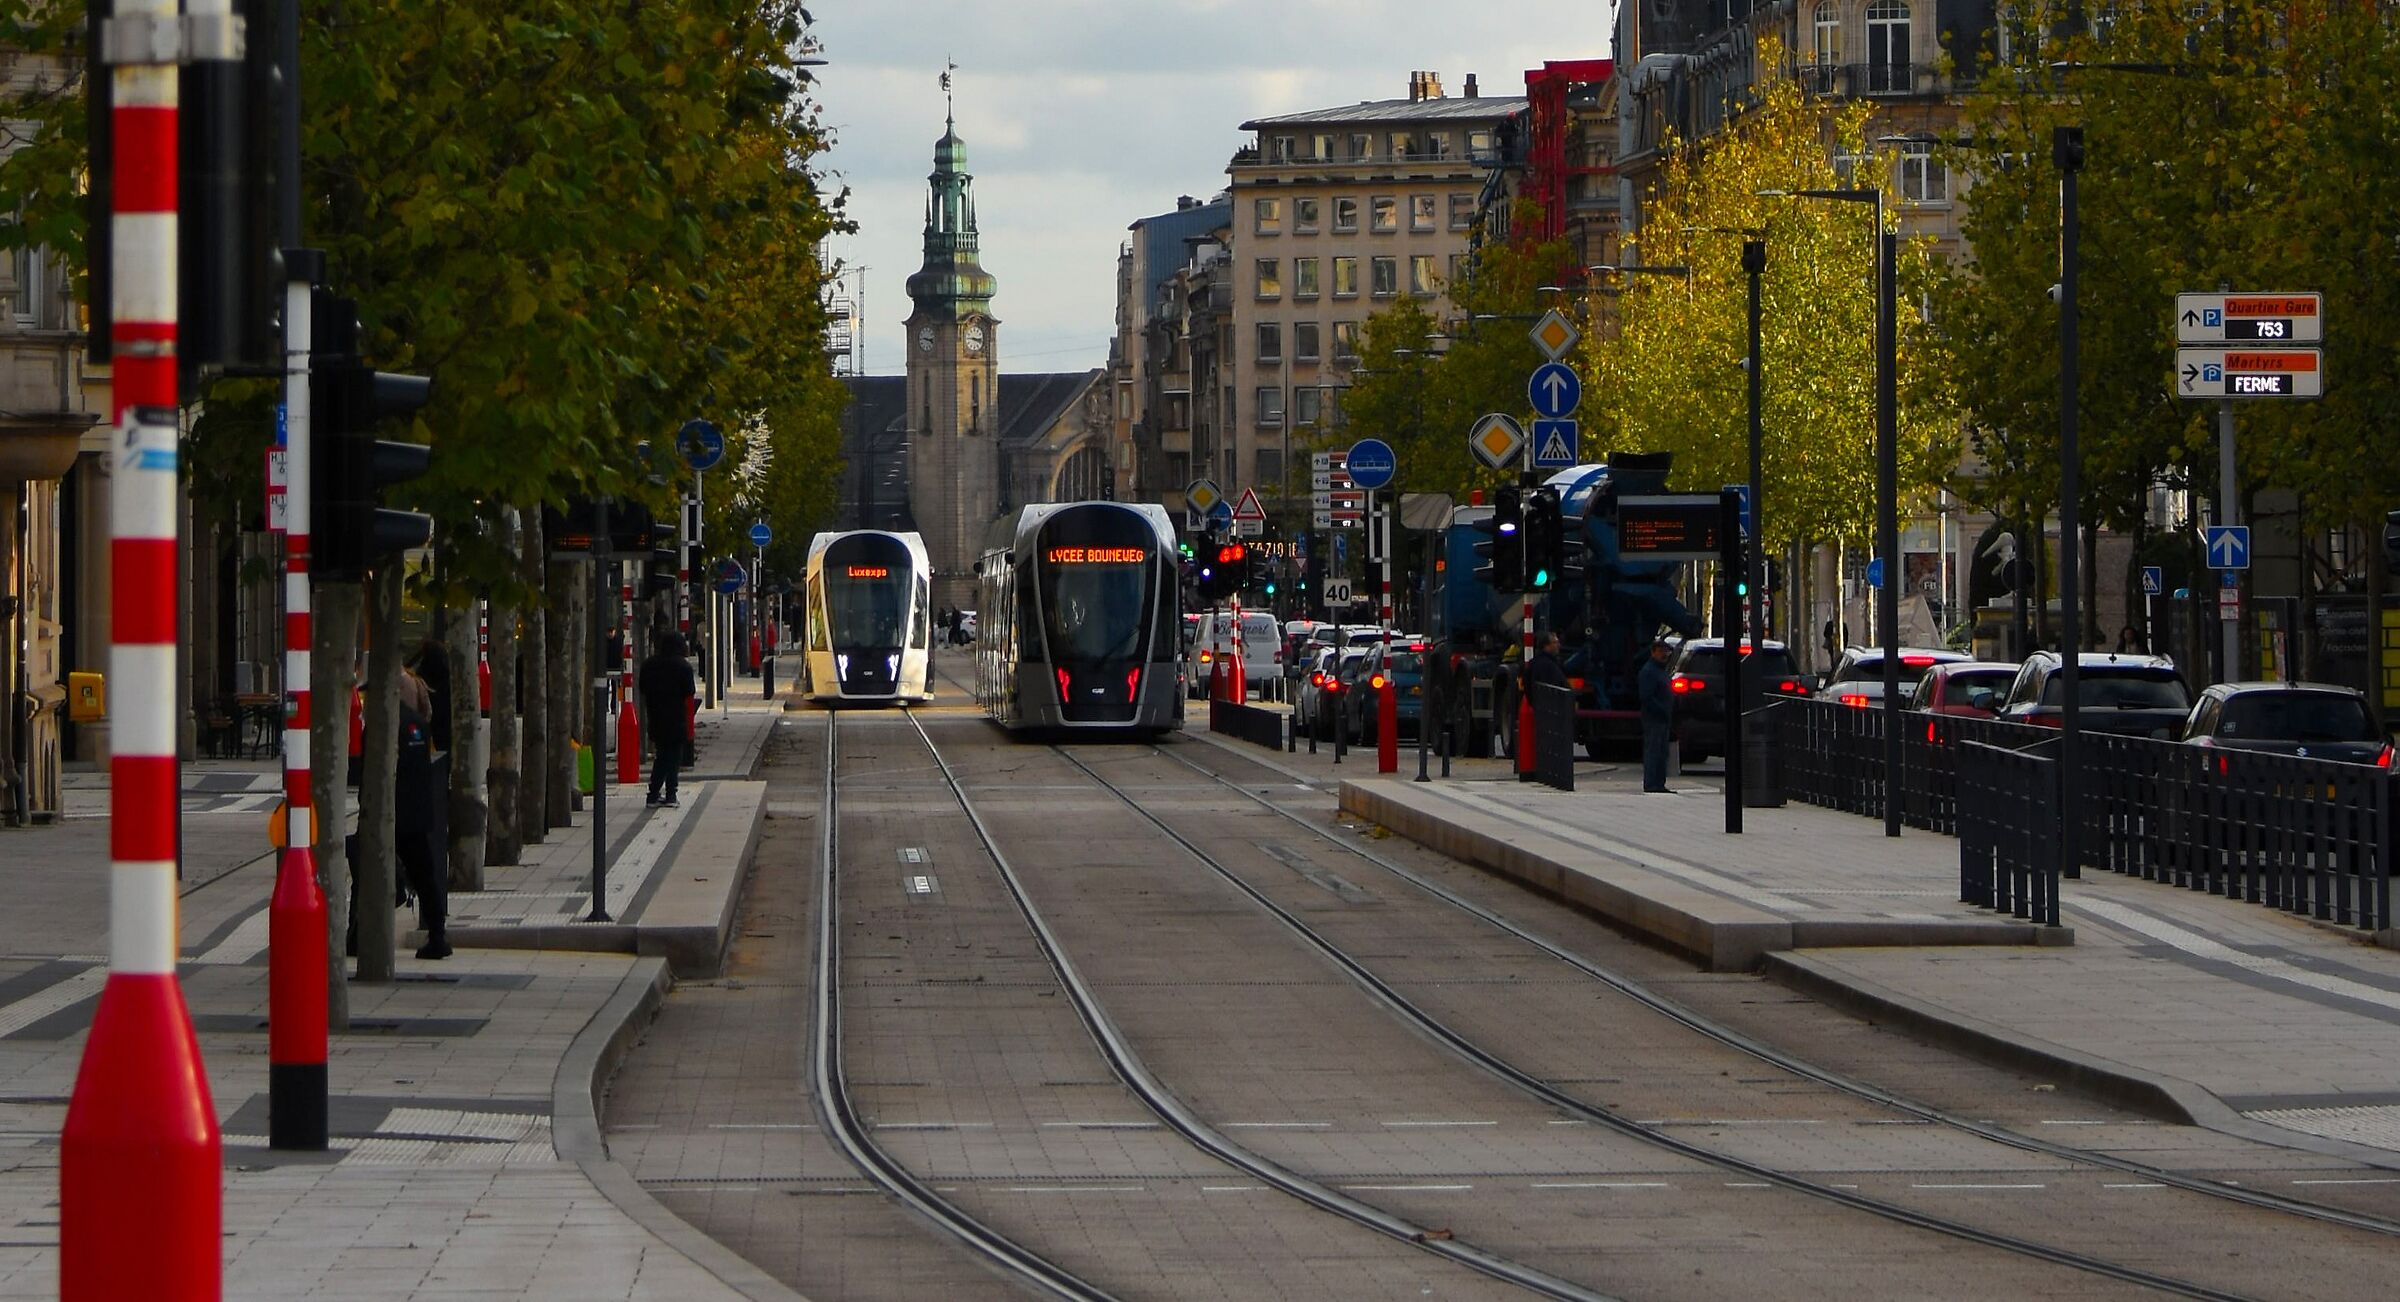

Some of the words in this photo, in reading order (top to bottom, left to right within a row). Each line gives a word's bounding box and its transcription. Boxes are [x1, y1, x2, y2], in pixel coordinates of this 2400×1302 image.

[2226, 300, 2279, 314] Quartier
[2284, 300, 2315, 314] Gare
[2256, 321, 2284, 337] 753
[2227, 356, 2283, 370] Martyrs
[2235, 376, 2281, 392] FERME
[271, 453, 277, 462] H
[271, 495, 278, 505] H
[1050, 549, 1084, 562] LYCEE
[1087, 549, 1144, 562] BOUNEWEG
[848, 565, 887, 578] Luxexpo
[1325, 584, 1350, 602] 40
